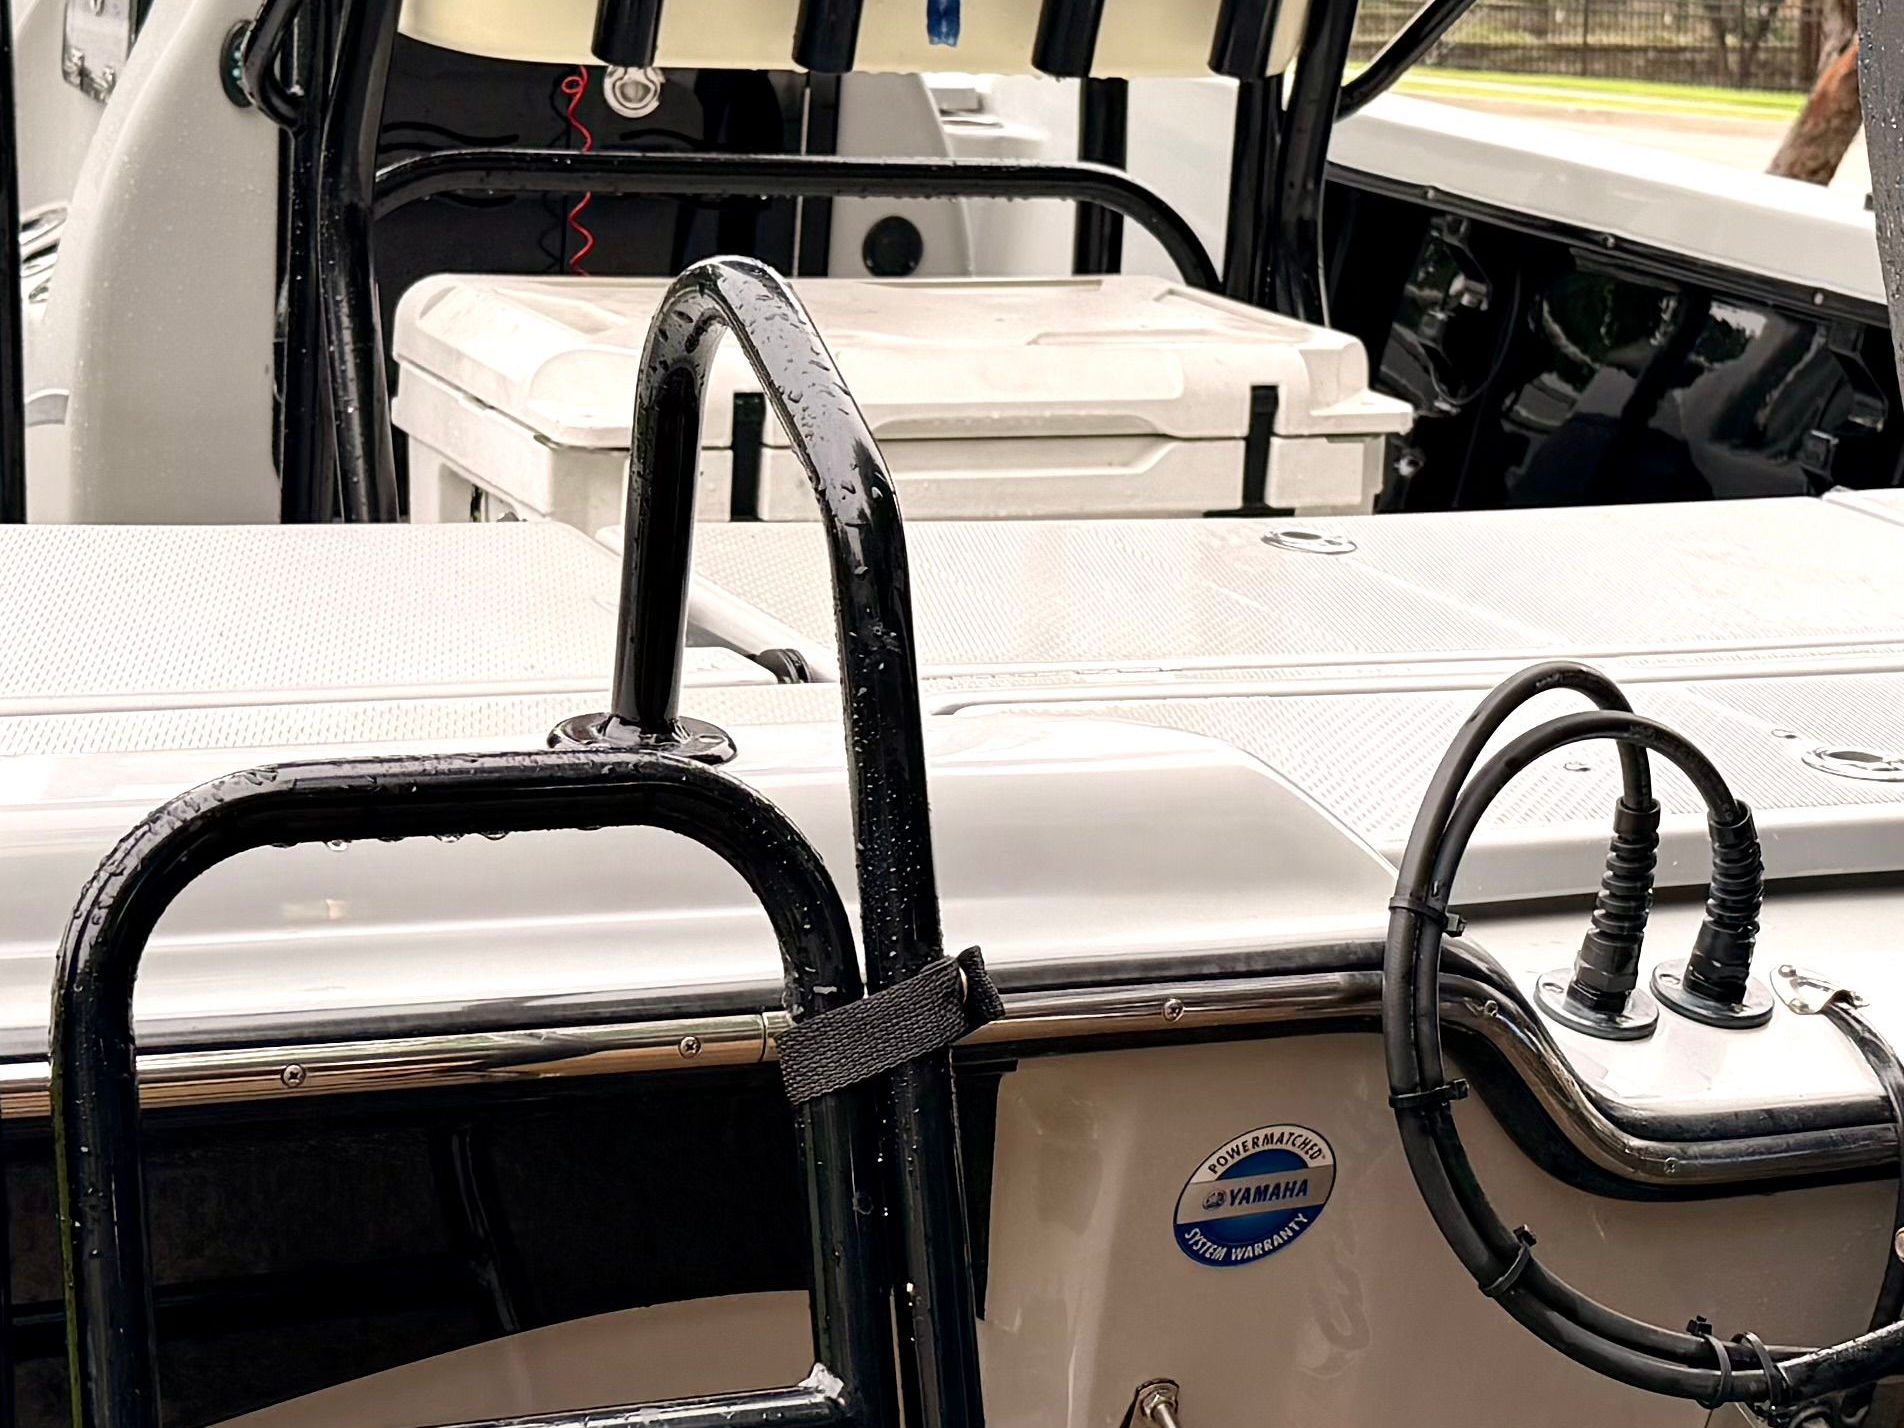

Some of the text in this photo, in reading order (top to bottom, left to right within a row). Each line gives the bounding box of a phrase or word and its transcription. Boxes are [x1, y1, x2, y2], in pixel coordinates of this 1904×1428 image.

[1207, 1132, 1323, 1175] POWERMATCHED
[1229, 1179, 1309, 1207] YAMAHA
[1184, 1212, 1309, 1261] SYSTEM WARRANTY
